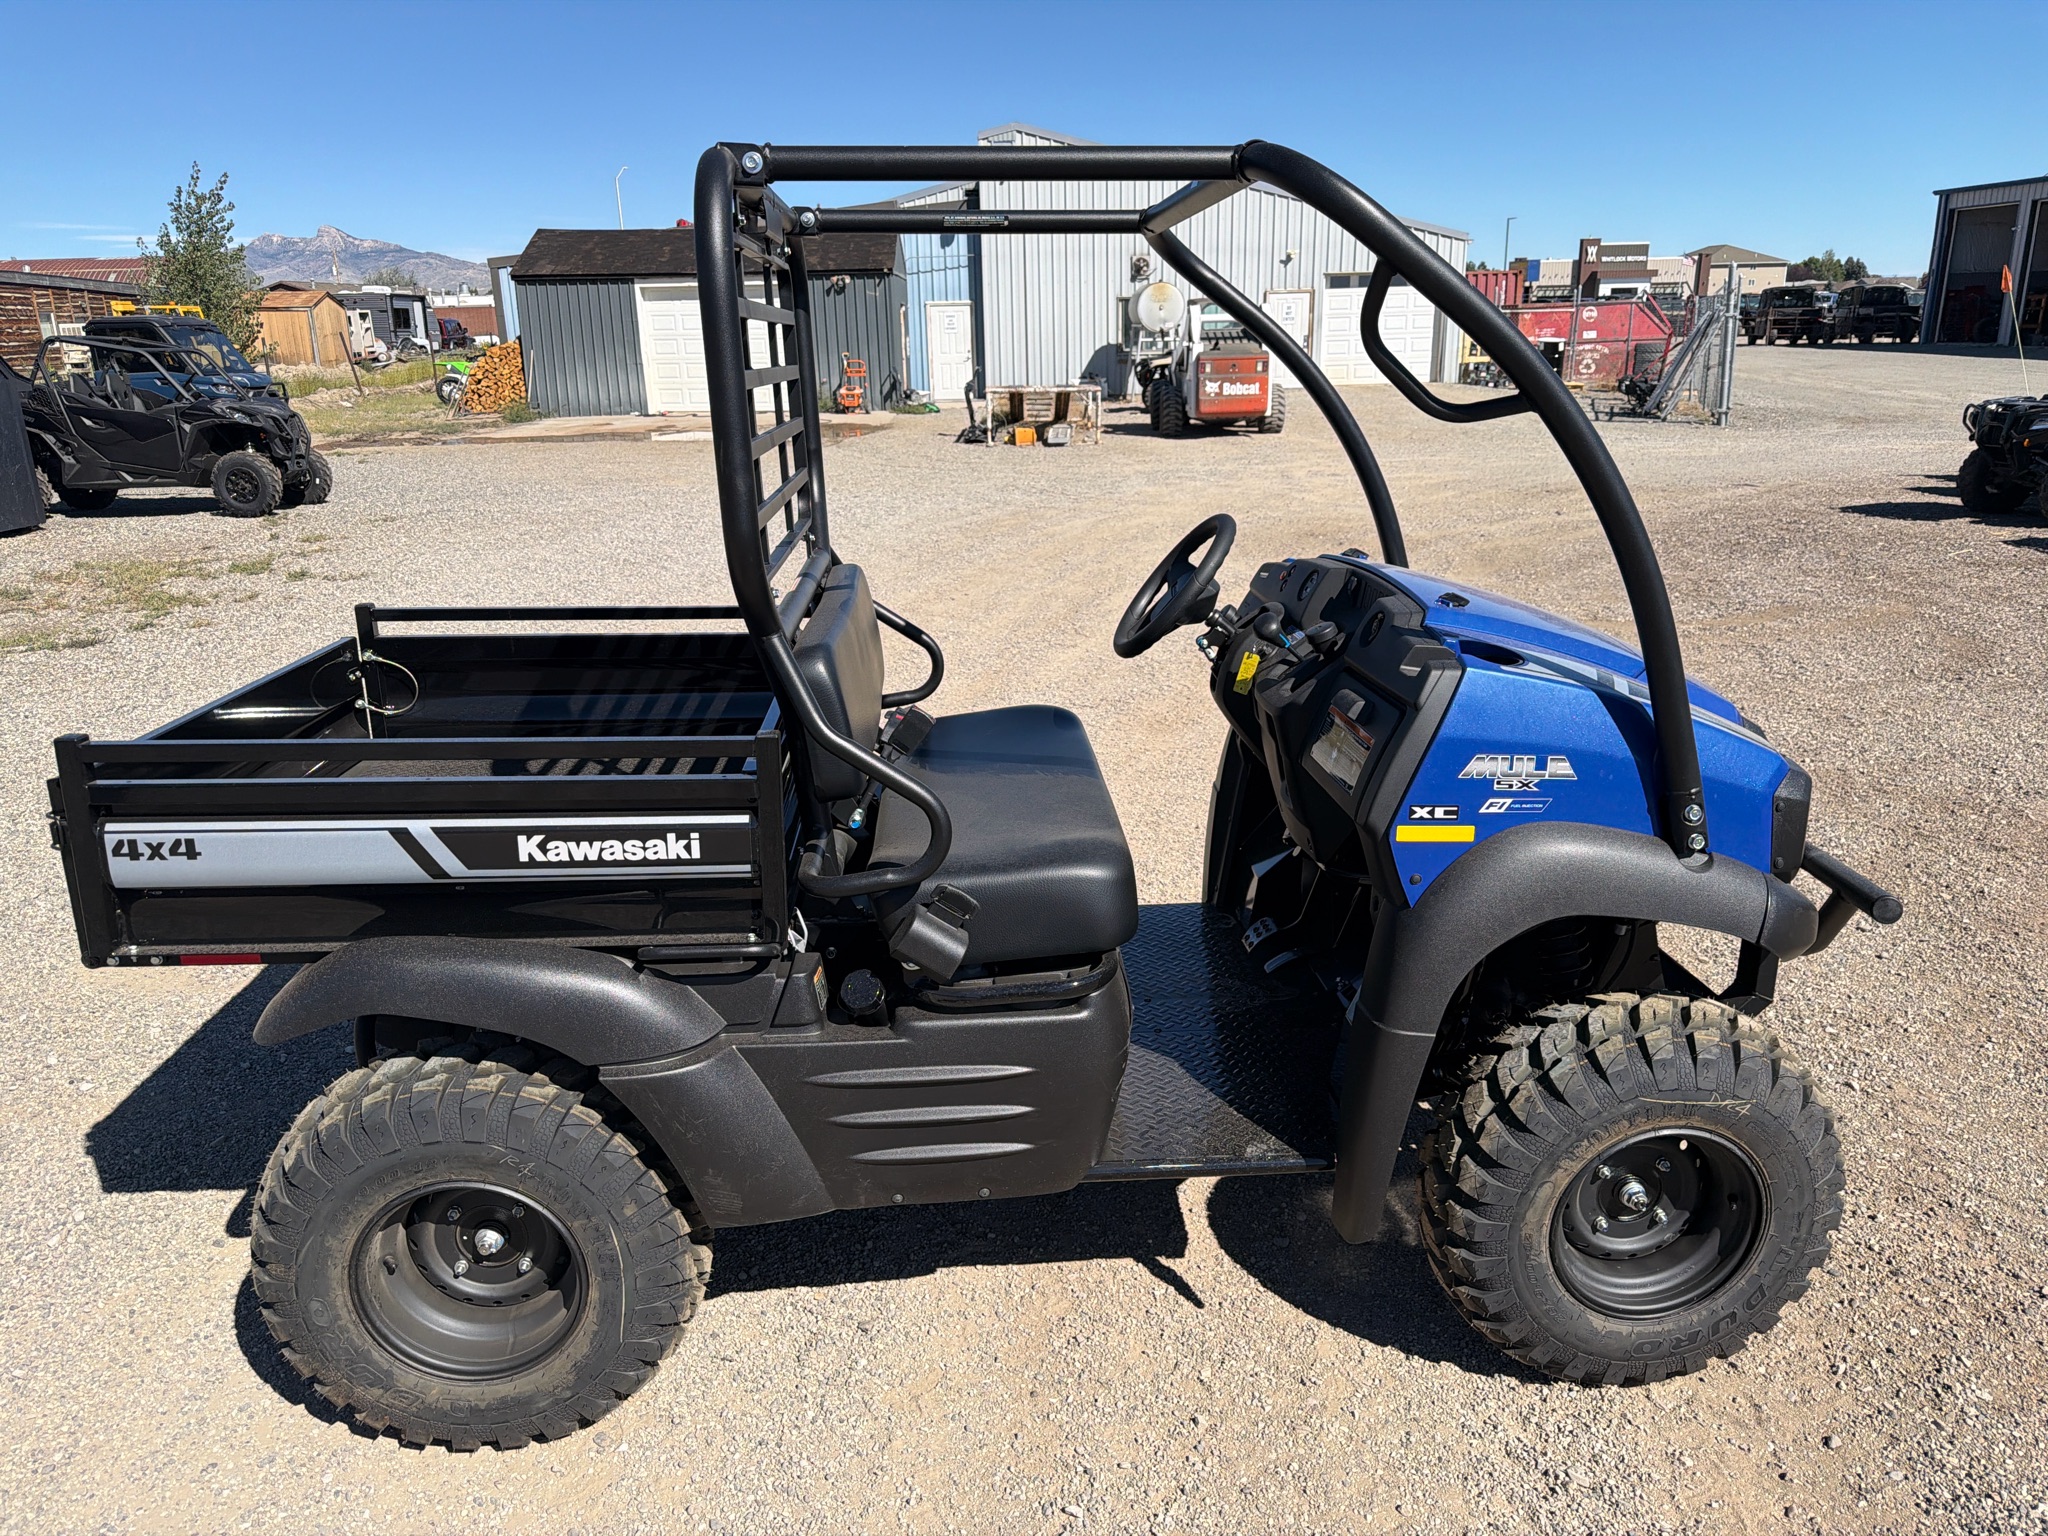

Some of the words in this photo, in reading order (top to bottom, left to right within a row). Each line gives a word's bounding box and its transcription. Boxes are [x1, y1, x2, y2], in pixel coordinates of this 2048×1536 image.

[1222, 382, 1260, 396] Bobcat
[1459, 754, 1578, 780] MULE
[1494, 779, 1540, 791] SX
[1410, 806, 1459, 819] XC
[1483, 800, 1509, 811] FI
[111, 837, 203, 862] 4x4
[516, 832, 701, 862] Kawasaki
[1631, 1282, 1770, 1358] DURO
[305, 1298, 427, 1409] DURO
